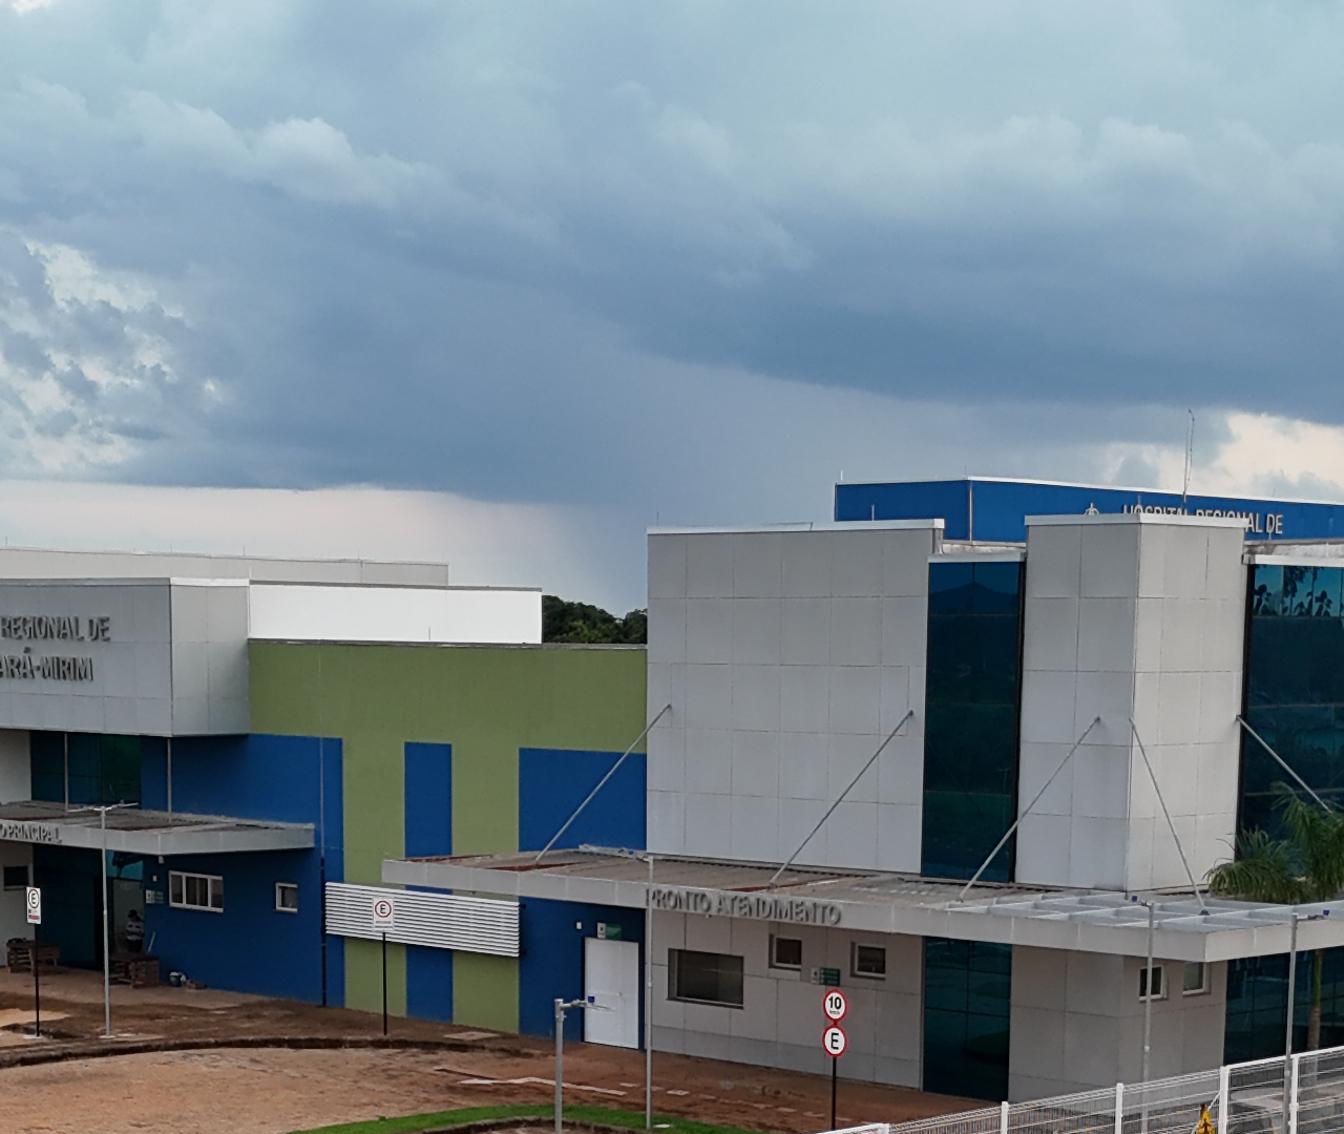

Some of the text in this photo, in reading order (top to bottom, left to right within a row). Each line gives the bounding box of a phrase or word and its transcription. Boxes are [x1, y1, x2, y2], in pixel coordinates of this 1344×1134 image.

[1265, 513, 1284, 534] DE
[1, 615, 85, 641] REGIONAL
[88, 617, 112, 642] DE
[8, 823, 63, 844] PRINCIPAL
[645, 888, 842, 926] PRONTO ATENDIMENTO
[828, 996, 842, 1010] 10
[831, 1032, 839, 1050] E
